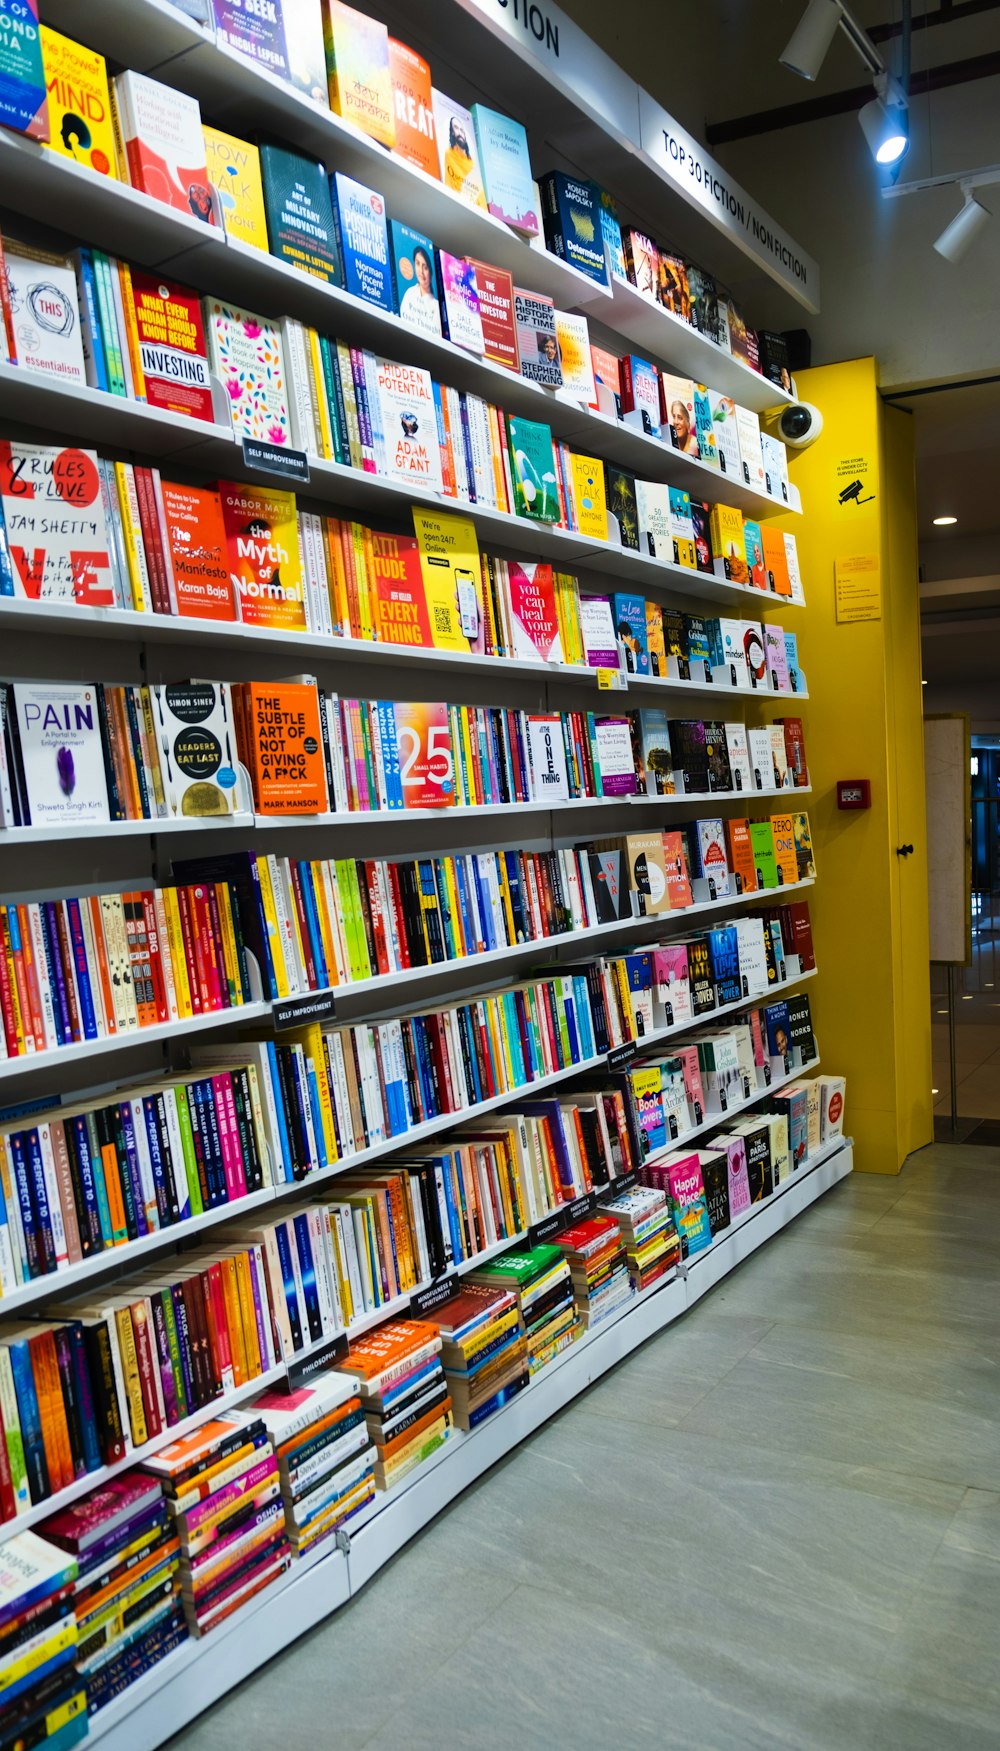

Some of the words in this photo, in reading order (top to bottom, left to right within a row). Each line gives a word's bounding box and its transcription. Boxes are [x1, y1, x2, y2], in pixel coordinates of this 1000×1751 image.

[498, 0, 559, 57] ION
[230, 34, 257, 55] NICOLE
[257, 48, 286, 67] LEPERA
[62, 47, 100, 76] Power
[46, 77, 105, 123] MIND
[662, 129, 686, 165] TOP
[688, 155, 702, 183] 30
[704, 170, 745, 224] FICTION
[291, 191, 304, 201] ART
[295, 182, 306, 193] THE
[567, 182, 590, 198] ROBERT
[564, 190, 594, 209] SAPOLSKY
[285, 199, 320, 223] MILITARY
[281, 212, 328, 242] INNOVATION
[343, 209, 384, 241] POSITIVE
[345, 228, 387, 266] THINKING
[566, 239, 604, 264] Determined
[634, 231, 654, 257] SITA
[355, 258, 384, 280] Norman
[357, 270, 384, 290] Vincent
[485, 280, 495, 292] THE
[361, 281, 381, 299] Peale
[39, 299, 63, 317] THIS
[141, 294, 164, 312] WHAT
[166, 299, 189, 320] EVERY
[515, 305, 554, 322] HISTORY
[525, 298, 554, 314] BRIEF
[138, 307, 165, 326] INDIAN
[167, 315, 197, 336] SHOULD
[517, 314, 530, 324] OF
[532, 317, 556, 330] TIME
[142, 323, 168, 342] KNOW
[169, 331, 197, 351] BEFORE
[25, 355, 80, 375] essentialism
[142, 348, 205, 383] INVESTING
[383, 362, 423, 383] HIDDEN
[521, 361, 562, 377] STEPHEN
[522, 370, 563, 386] HAWKING
[379, 376, 431, 401] POTENTIAL
[397, 440, 427, 458] ADAM
[248, 448, 262, 459] SELF
[262, 451, 304, 468] IMPROVEMENT
[6, 456, 27, 495] 8
[31, 457, 86, 478] RULES
[575, 464, 599, 477] HOW
[837, 468, 867, 476] SURVEILLANCE
[32, 481, 44, 493] OF
[46, 482, 87, 498] LOVE
[578, 484, 600, 500] TALK
[226, 496, 261, 511] GABOR
[264, 502, 292, 515] MATÉ
[9, 515, 36, 530] JAY
[41, 518, 97, 536] SHETTY
[250, 524, 272, 540] the
[421, 519, 441, 532] We're
[424, 532, 441, 544] open
[236, 538, 289, 566] Myth
[425, 543, 448, 555] Online.
[175, 559, 228, 579] Manifesto
[259, 566, 272, 579] of
[375, 556, 407, 580] TUDE
[177, 580, 205, 595] Karan
[206, 584, 229, 600] Bajaj
[231, 574, 302, 602] Normal
[519, 585, 540, 596] you
[526, 597, 545, 608] can
[379, 601, 418, 623] EVERY
[520, 605, 544, 621] heal
[381, 622, 423, 644] THING
[527, 621, 553, 631] your
[690, 621, 704, 632] John
[534, 632, 552, 647] life
[688, 630, 708, 642] Grisham
[725, 650, 745, 660] mindset
[169, 698, 192, 708] SIMON
[193, 698, 214, 706] SINEK
[256, 697, 281, 711] THE
[24, 703, 94, 731] PAIN
[257, 711, 306, 725] SUBTLE
[258, 726, 283, 738] ART
[287, 726, 306, 738] OF
[41, 739, 85, 747] Enlightenment
[178, 742, 215, 751] LEADERS
[259, 740, 286, 752] NOT
[177, 755, 195, 764] EAT
[197, 753, 220, 762] LAST
[260, 754, 306, 766] GIVING
[262, 768, 271, 780] A
[541, 773, 560, 784] THING
[37, 803, 65, 812] Shweta
[66, 802, 87, 812] Singh
[88, 801, 103, 809] Kirti
[264, 800, 285, 808] MARK
[287, 799, 318, 808] MANSON
[772, 820, 792, 833] ZERO
[629, 840, 661, 849] MURAKAMI
[776, 838, 793, 851] ONE
[638, 893, 644, 904] 17
[279, 1010, 292, 1020] SELF
[293, 1001, 332, 1016] IMPROVEMENT
[666, 1005, 672, 1015] 22
[319, 1071, 330, 1110] HABIT
[638, 1095, 660, 1112] Book
[639, 1110, 663, 1127] Lovers
[125, 1123, 136, 1151] PAIN
[149, 1122, 161, 1166] PERFECT
[750, 1143, 767, 1157] PARIS
[17, 1162, 31, 1204] PERFECT
[674, 1174, 700, 1194] Happy
[679, 1191, 701, 1207] Place
[537, 1221, 558, 1237] PSYCHOLOGY
[418, 1284, 447, 1304] MINDFULNESS
[422, 1289, 451, 1309] SPIRITUALITY
[302, 1349, 337, 1375] PHILOSOPHY
[256, 1504, 278, 1524] OSHO
